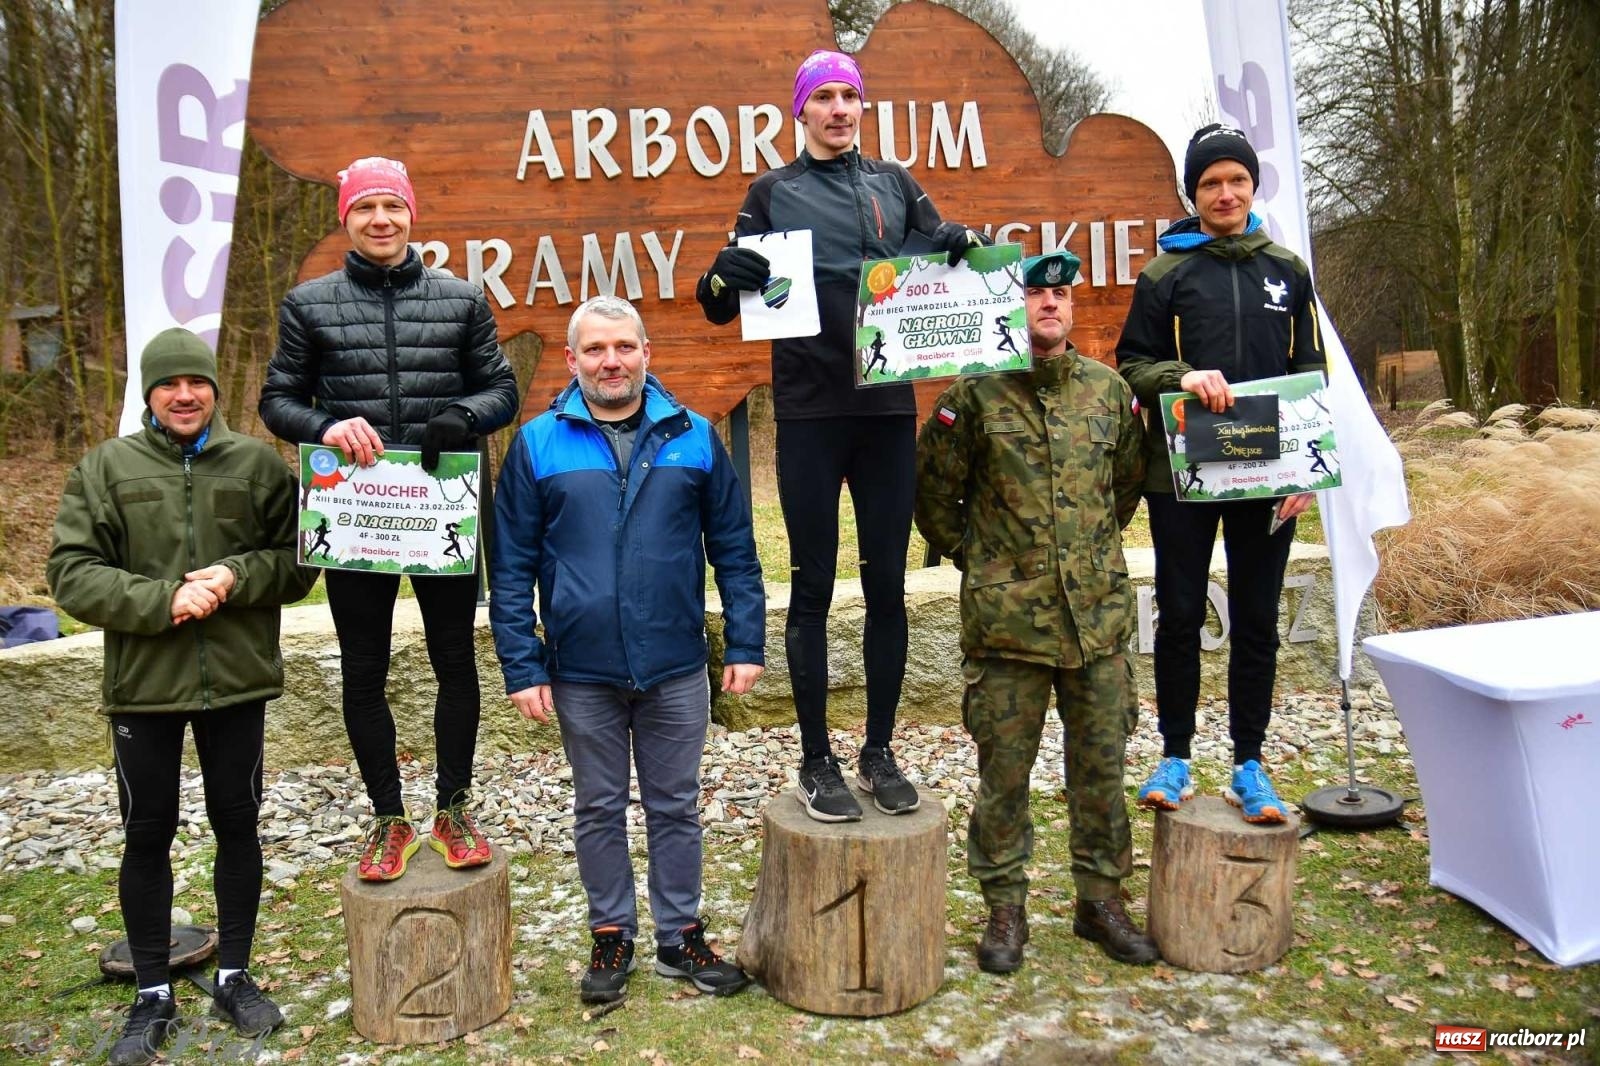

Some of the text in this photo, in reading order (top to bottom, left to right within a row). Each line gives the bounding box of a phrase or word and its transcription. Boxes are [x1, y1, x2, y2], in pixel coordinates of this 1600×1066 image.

[515, 100, 988, 181] ARBORUM
[906, 282, 950, 297] 500 ZŁ
[886, 306, 904, 315] BIEG
[907, 301, 959, 313] TWARDZIELA
[898, 312, 983, 333] NAGRODA
[903, 328, 982, 349] GŁÓWNA
[916, 350, 955, 361] Racibórz
[1221, 441, 1233, 455] 3
[318, 455, 329, 468] 2
[665, 452, 681, 462] 4F
[1243, 462, 1257, 470] 200
[1231, 475, 1270, 485] Racibórz
[353, 482, 429, 498] VOUCHER
[333, 497, 353, 506] BIEG
[356, 499, 411, 511] TWARDZIELA
[337, 512, 437, 531] 2 NAGRODA
[359, 532, 369, 540] 4F
[375, 533, 390, 541] 300
[391, 534, 401, 542] ZŁ
[361, 547, 429, 558] Racibórz OSiR
[1221, 854, 1277, 957] 3
[812, 875, 883, 994] 1
[380, 905, 466, 1019] 2
